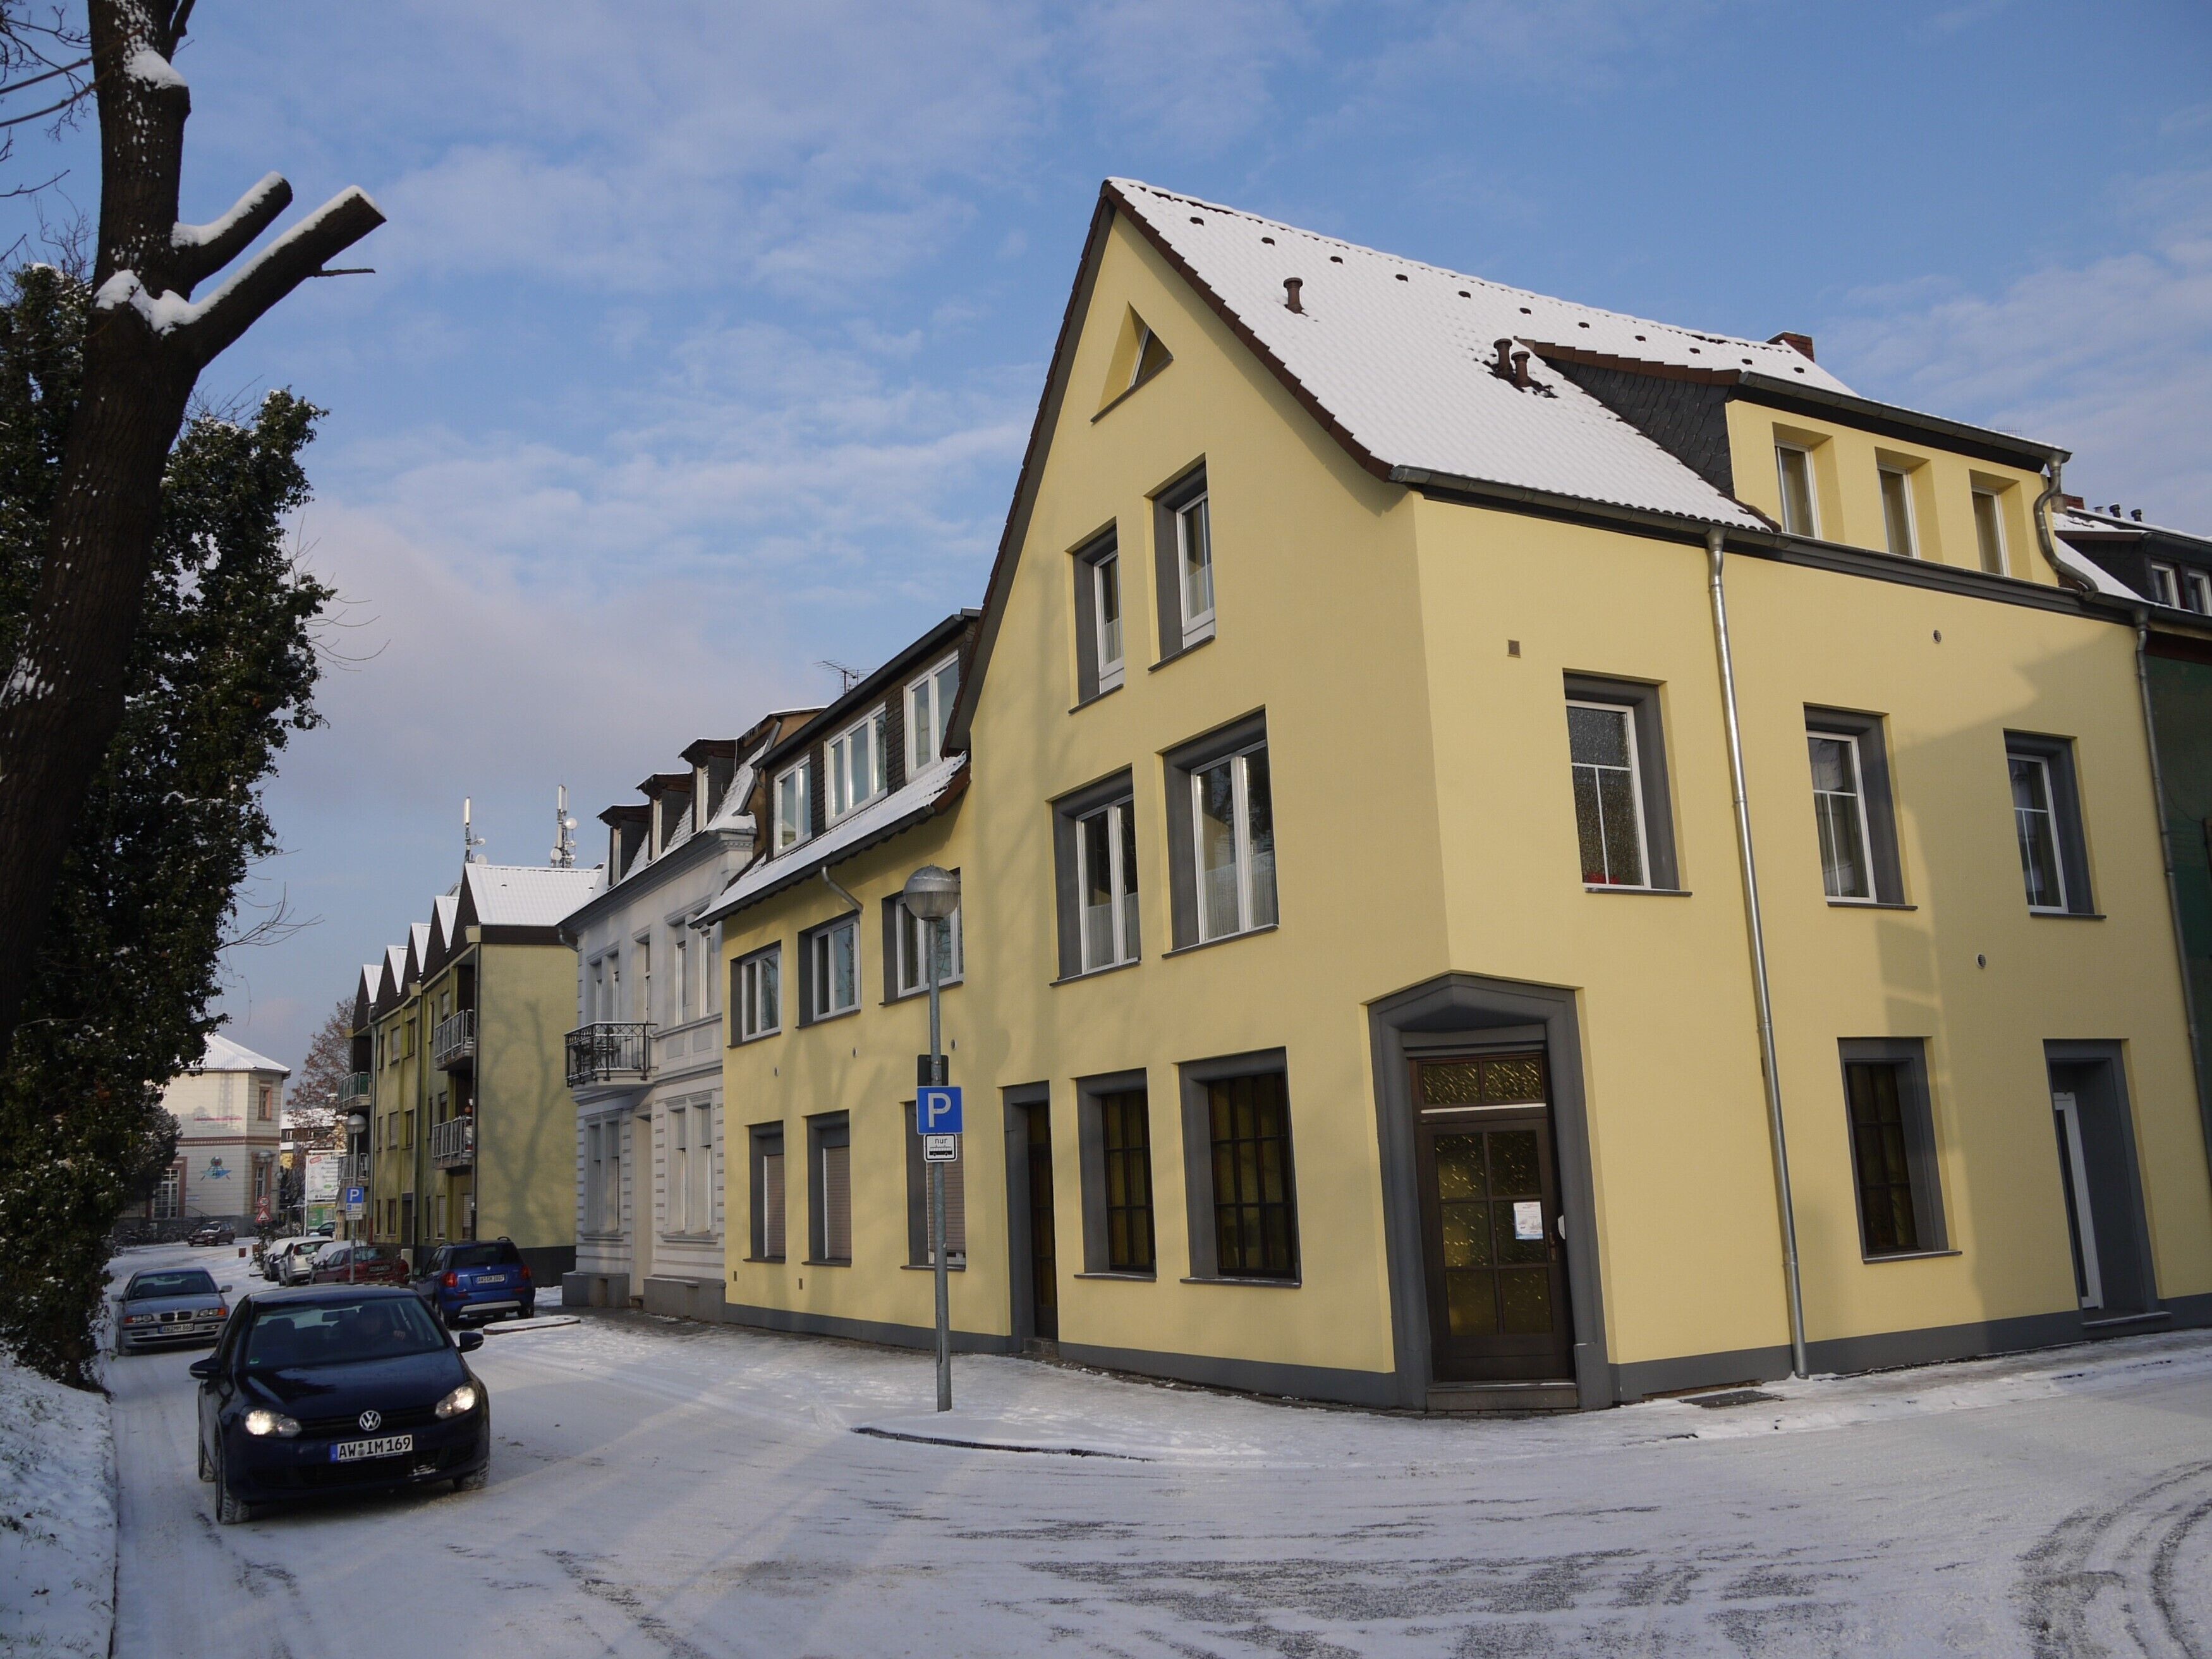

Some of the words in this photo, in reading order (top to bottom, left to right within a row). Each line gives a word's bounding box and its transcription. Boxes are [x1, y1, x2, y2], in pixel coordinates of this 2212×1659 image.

[928, 1092, 951, 1127] P
[349, 1189, 360, 1201] P
[339, 1443, 356, 1459] AW
[367, 1440, 384, 1455] IM
[387, 1437, 411, 1452] 169
